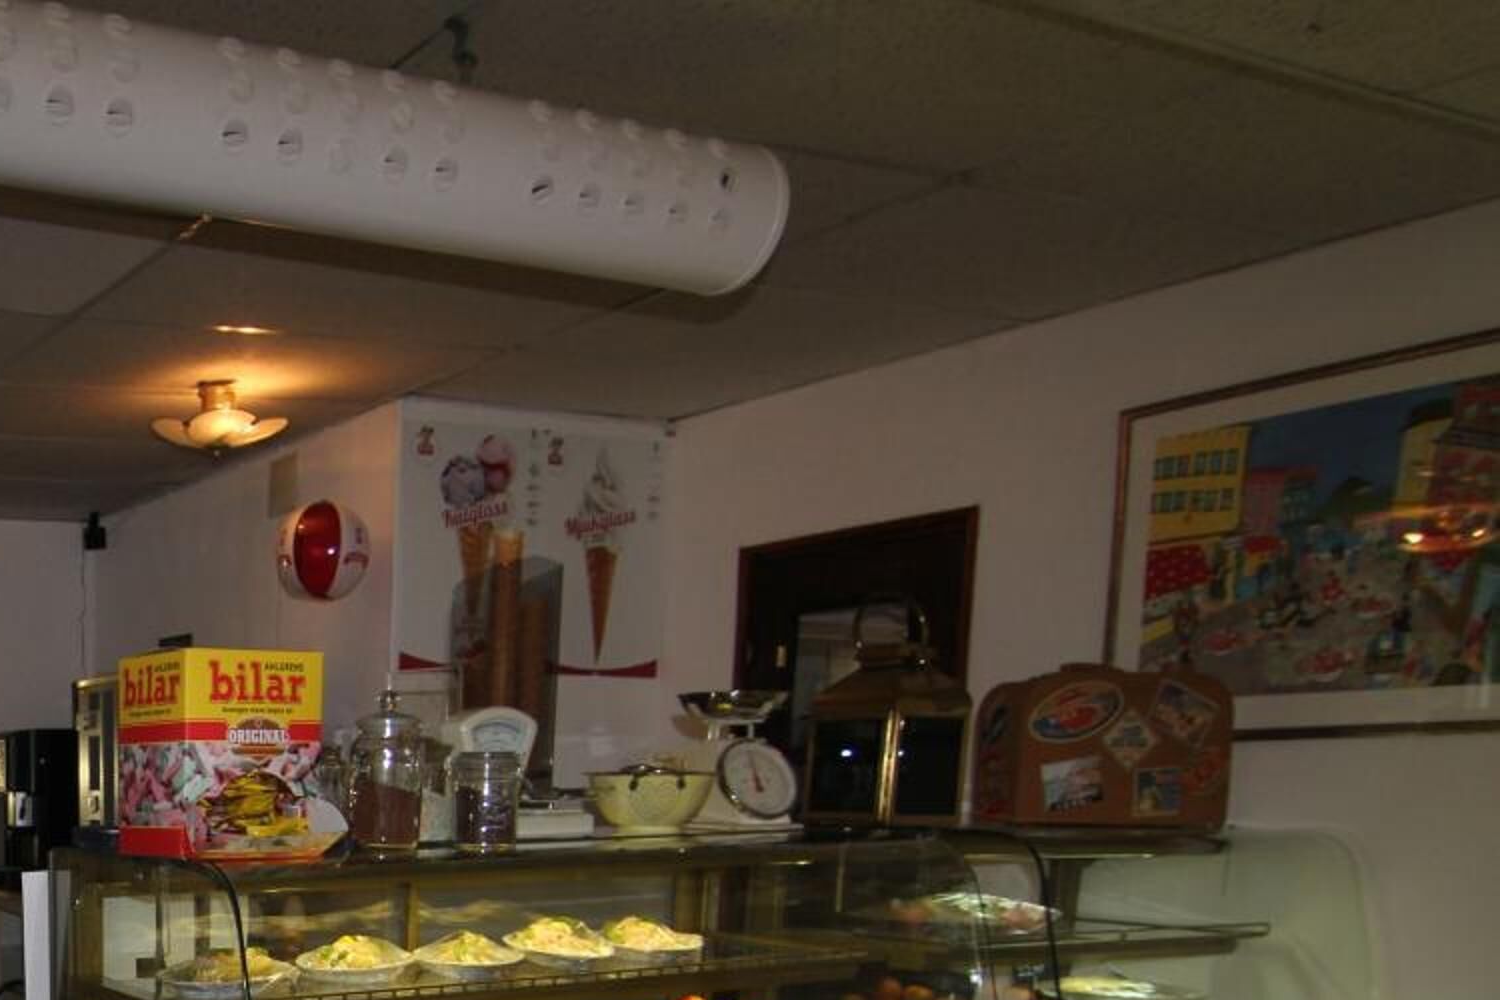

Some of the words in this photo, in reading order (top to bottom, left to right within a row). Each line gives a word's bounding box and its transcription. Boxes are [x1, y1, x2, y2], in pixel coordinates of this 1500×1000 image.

[123, 665, 181, 706] bilar
[208, 660, 307, 703] bilar
[228, 728, 290, 746] ORIGINAL
